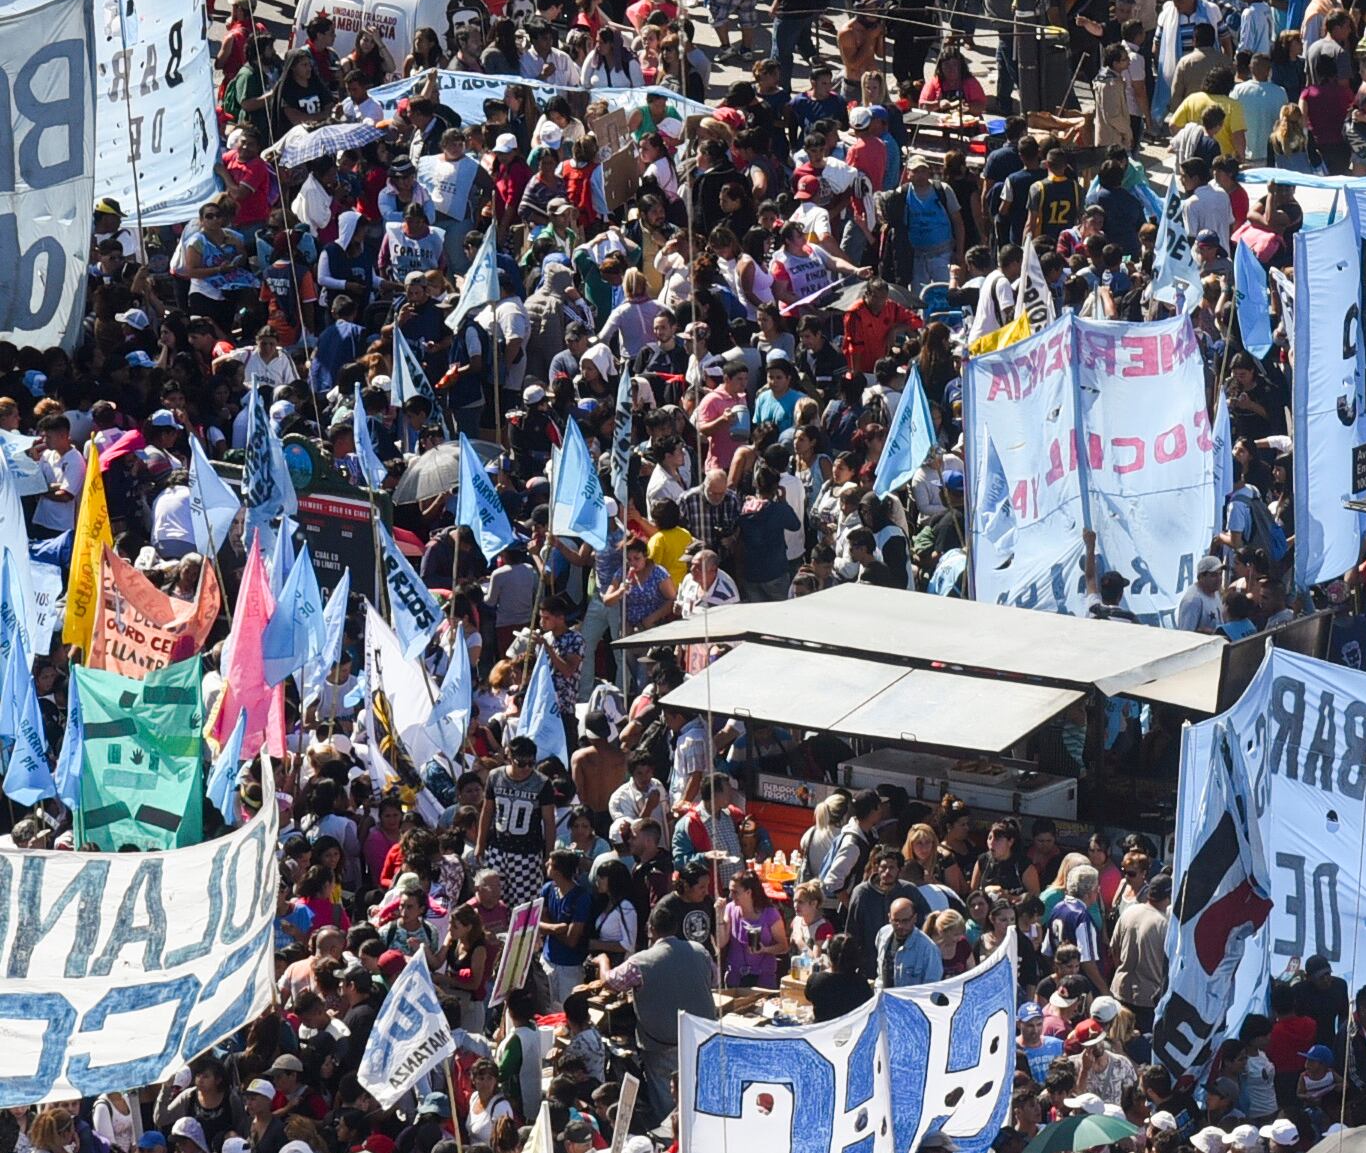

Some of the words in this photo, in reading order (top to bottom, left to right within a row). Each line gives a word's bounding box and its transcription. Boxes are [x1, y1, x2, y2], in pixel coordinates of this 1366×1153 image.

[363, 11, 397, 26] TRASLADO
[1047, 200, 1070, 224] 12
[471, 473, 504, 513] BARRIOS
[20, 719, 49, 764] BARRIOS
[21, 757, 37, 774] PIE
